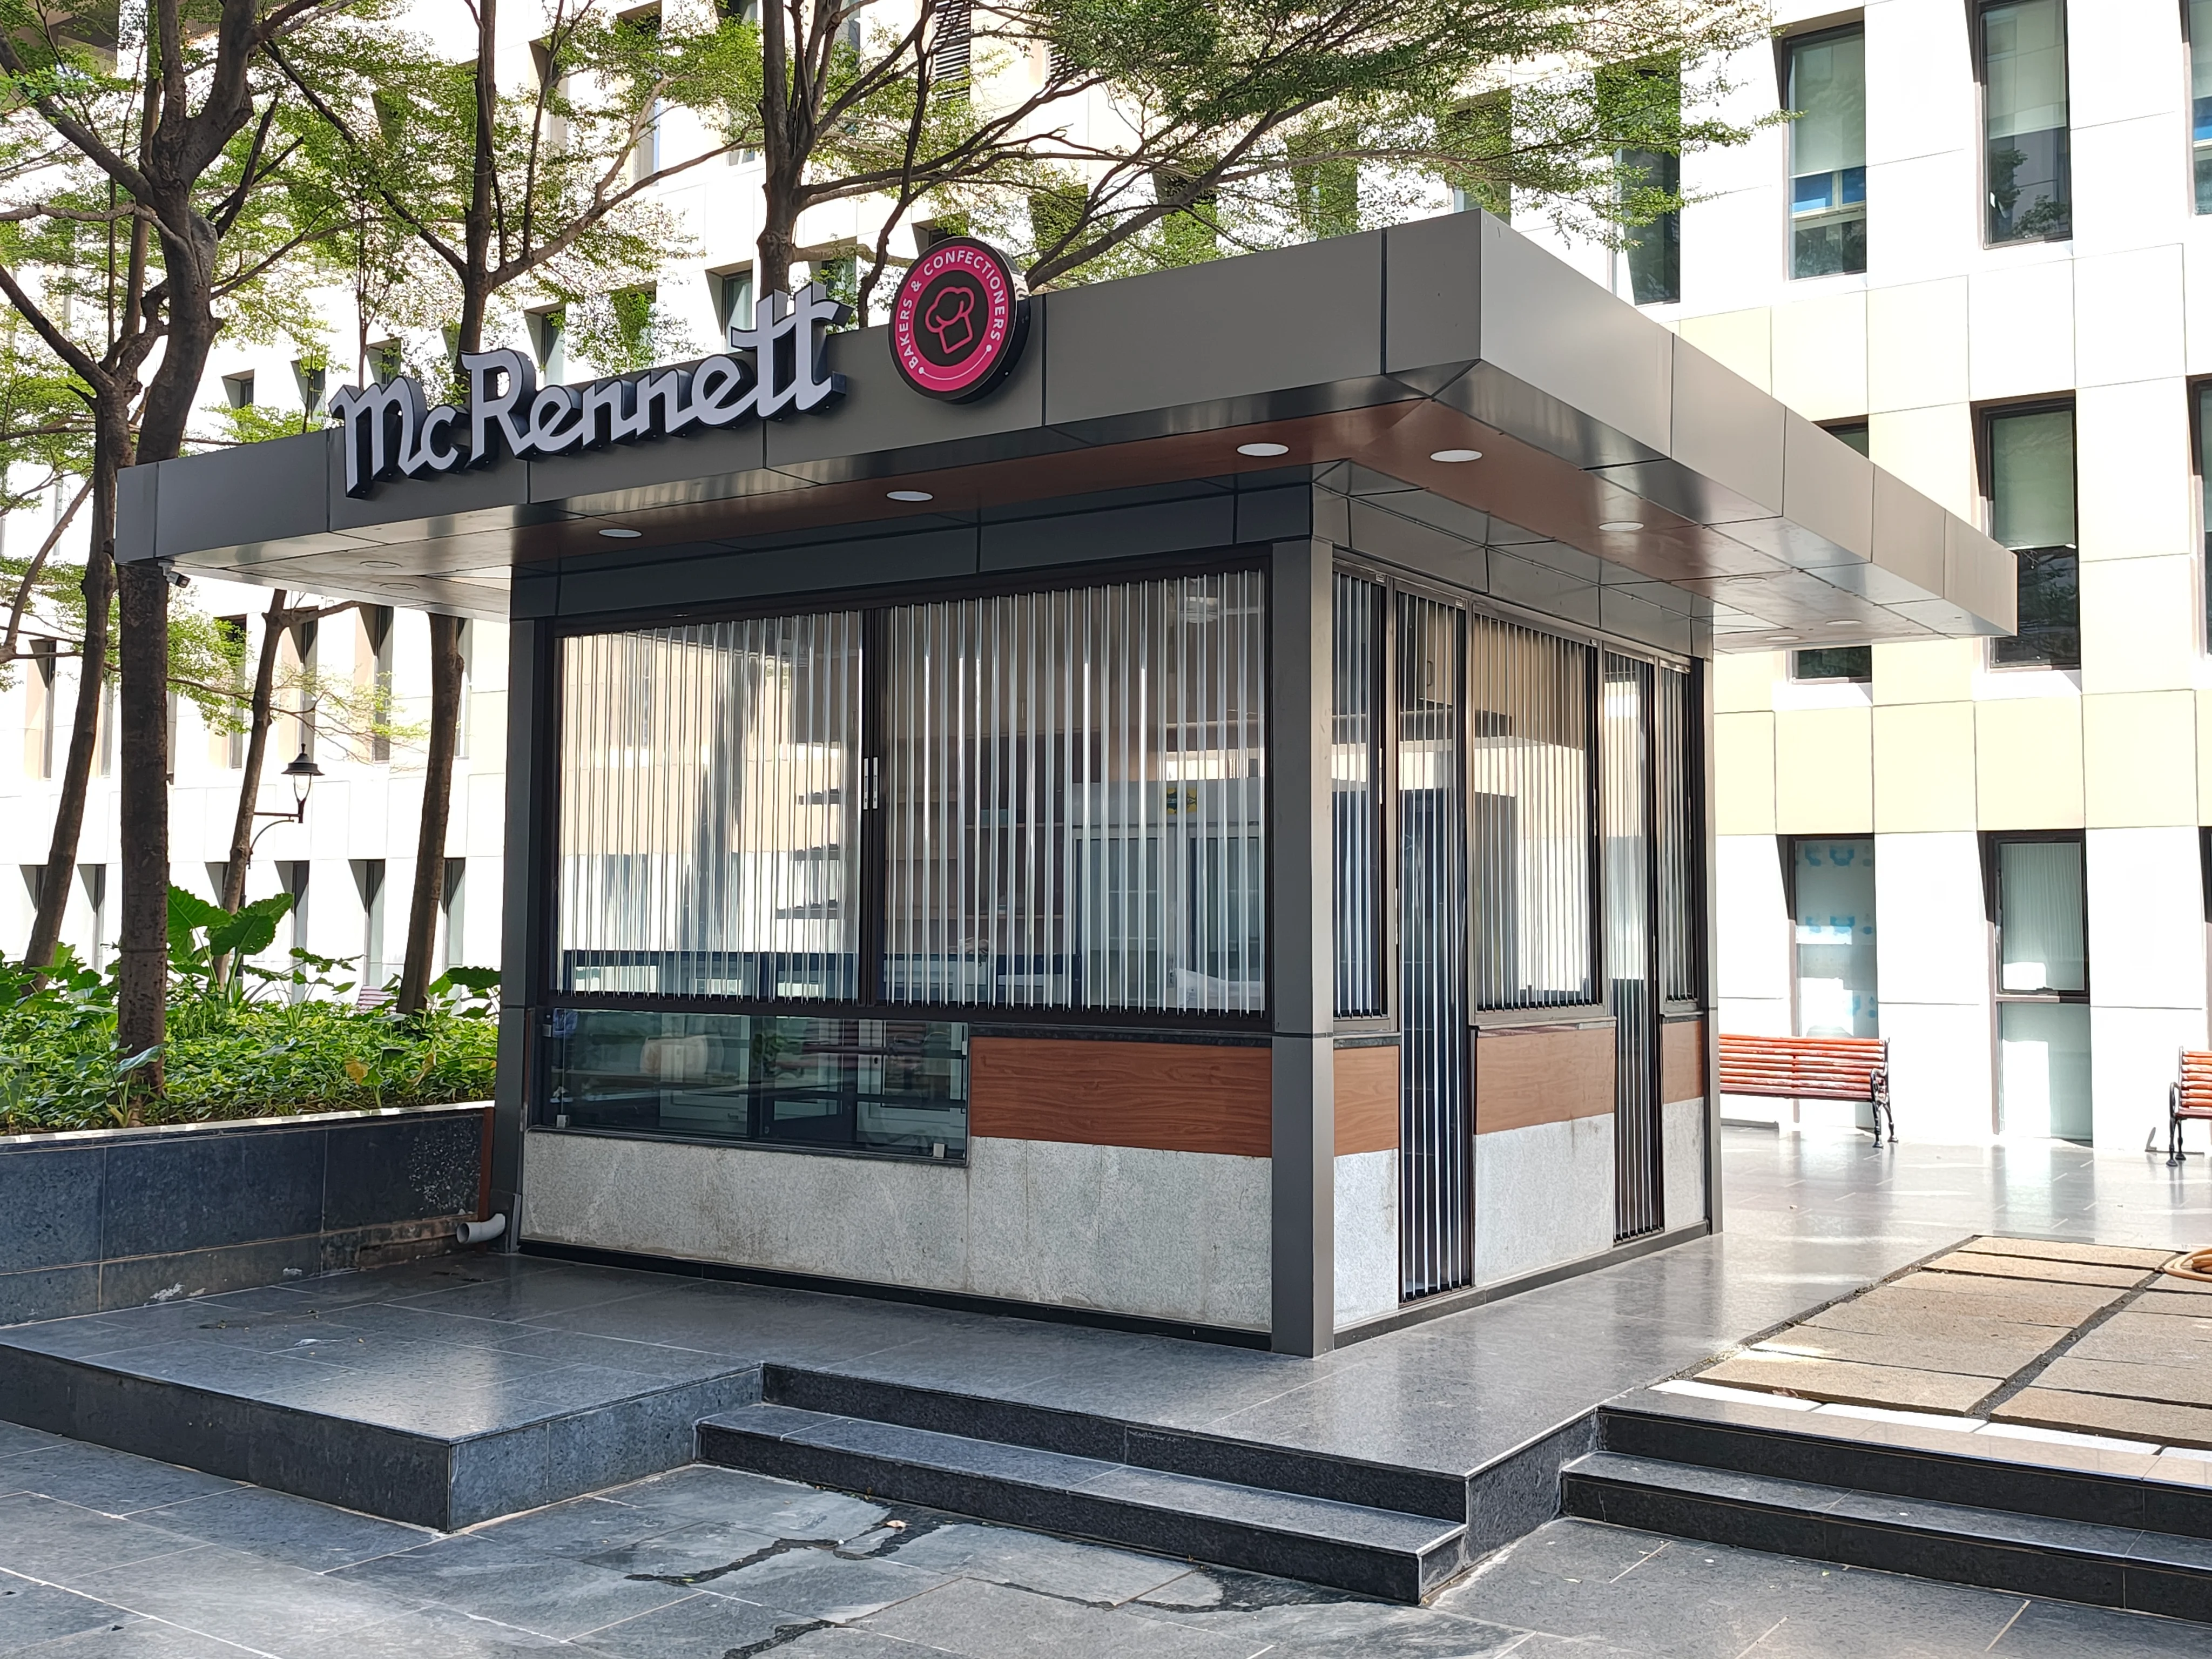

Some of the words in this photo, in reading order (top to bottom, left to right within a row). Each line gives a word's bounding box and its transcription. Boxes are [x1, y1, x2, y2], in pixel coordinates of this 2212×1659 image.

[328, 282, 845, 498] McRennett
[899, 298, 919, 369] BAKERS
[911, 280, 922, 292] &
[923, 250, 1005, 341] CONFECTIONERS
